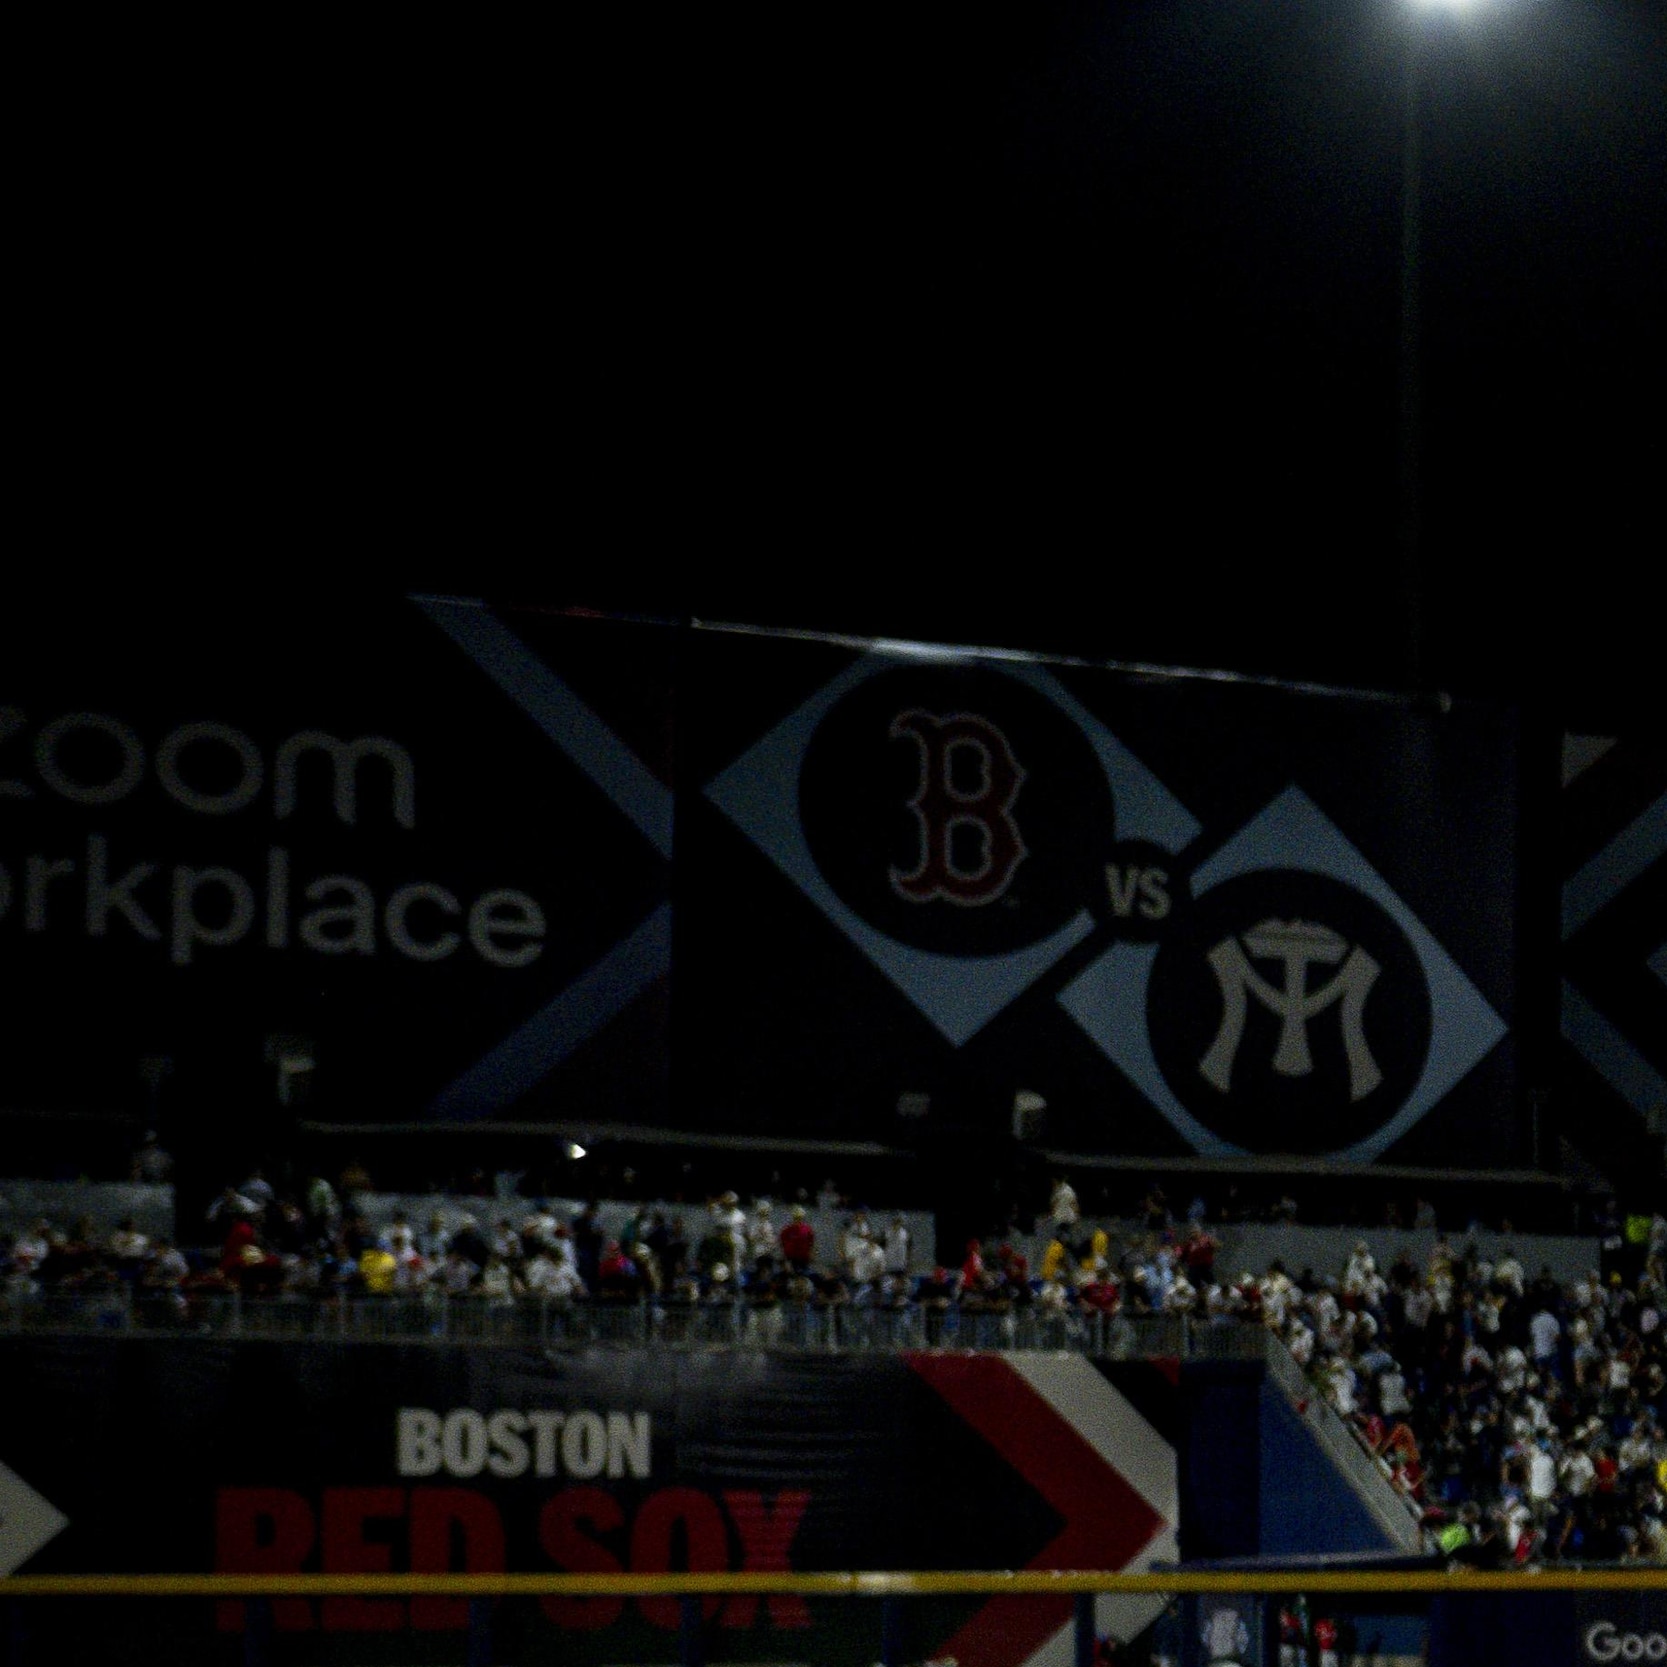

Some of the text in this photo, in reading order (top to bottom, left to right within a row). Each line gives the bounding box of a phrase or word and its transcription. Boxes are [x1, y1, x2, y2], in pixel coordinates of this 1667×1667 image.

[889, 708, 1029, 907] B
[0, 830, 550, 968] rkplace
[1105, 861, 1172, 921] VS
[399, 1409, 653, 1479] BOSTON
[211, 1484, 812, 1634] RED SOX
